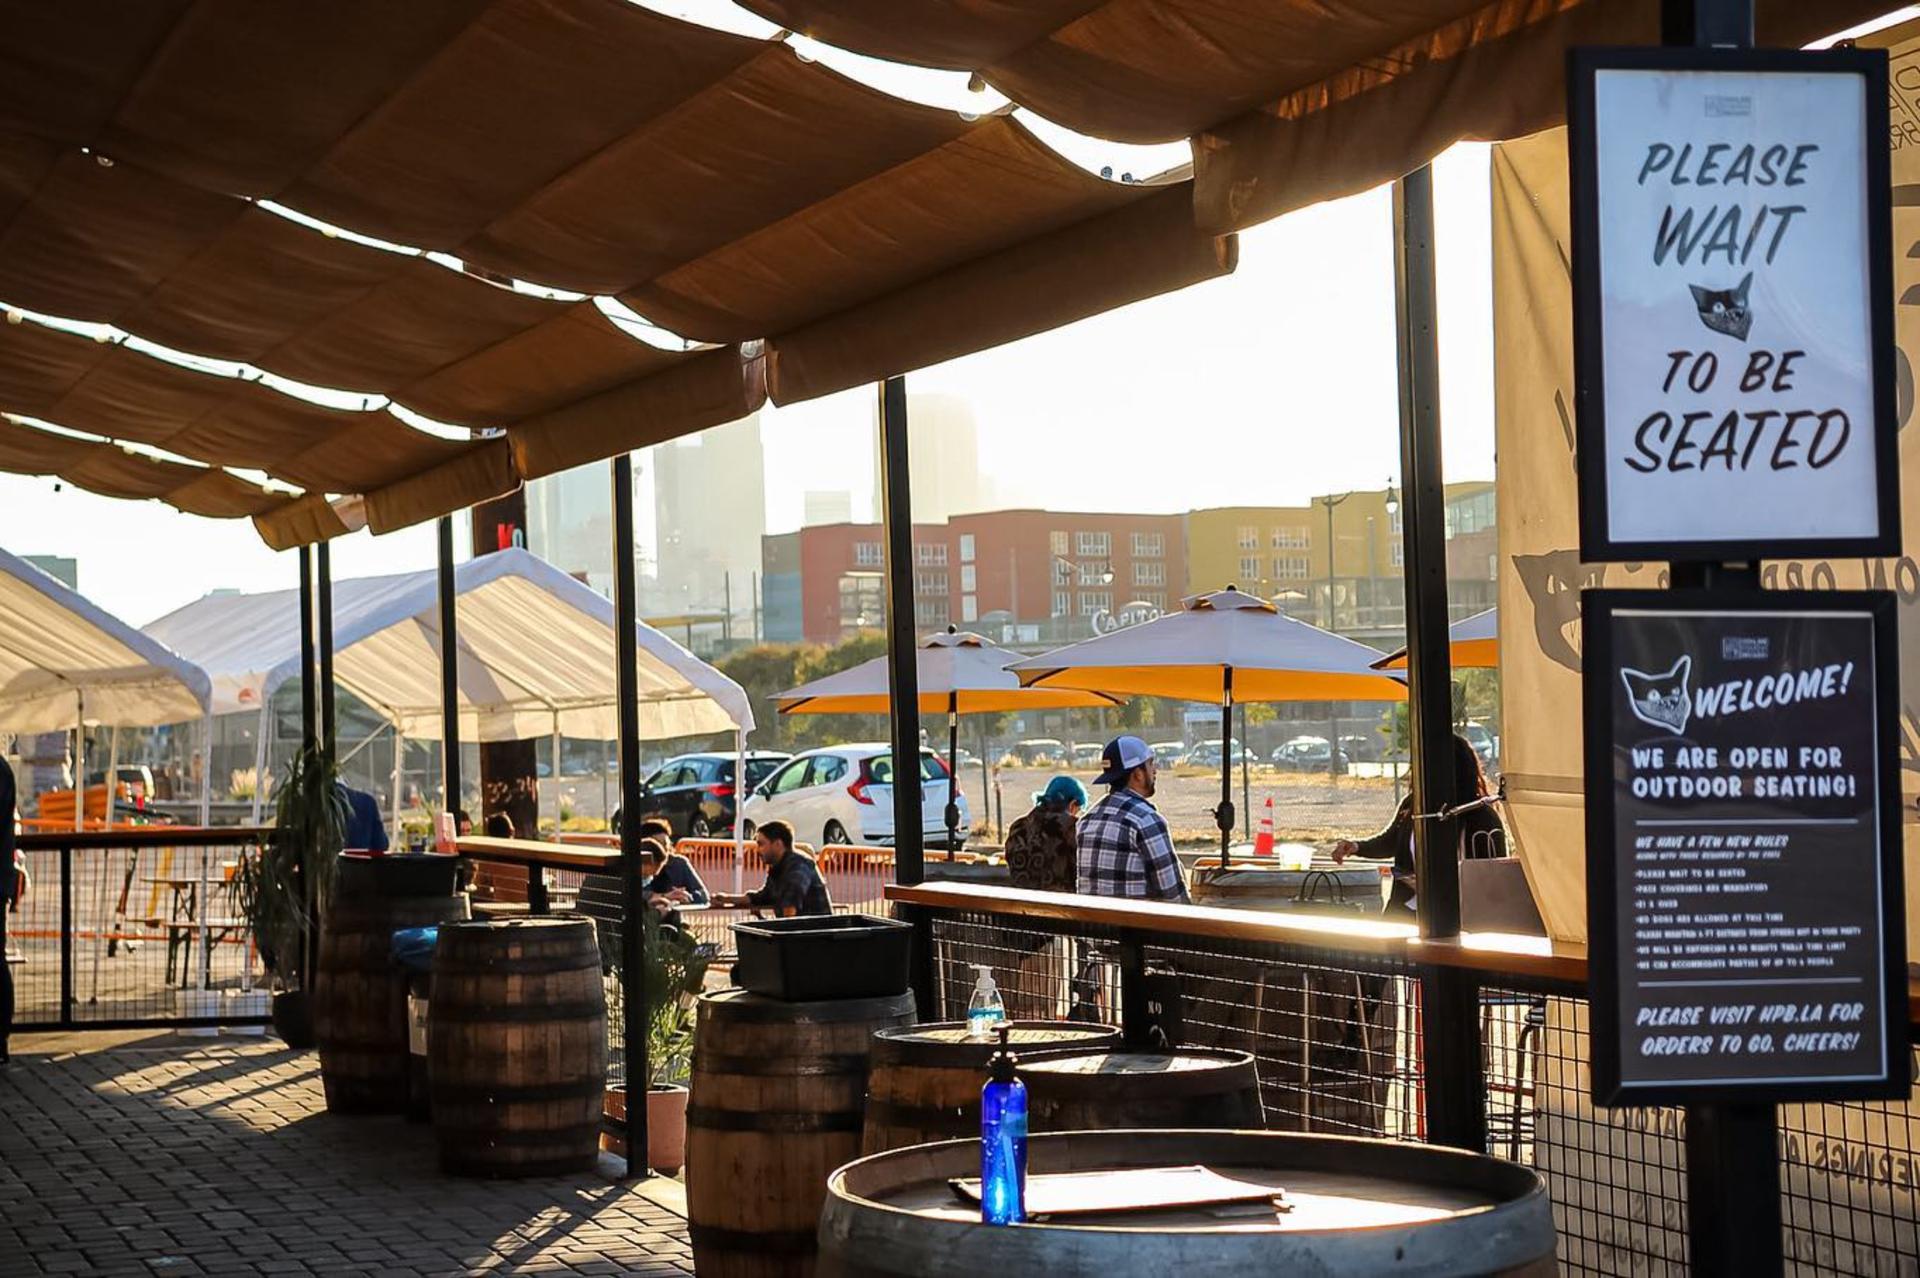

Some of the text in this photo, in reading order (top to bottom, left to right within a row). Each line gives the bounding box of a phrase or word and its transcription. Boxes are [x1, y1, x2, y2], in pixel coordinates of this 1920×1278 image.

[1638, 143, 1820, 186] PLEASE
[1653, 204, 1806, 266] WAIT
[1663, 350, 1806, 393] TO BE
[1623, 408, 1851, 474] SEATED
[1091, 608, 1165, 636] CAPITO
[1694, 661, 1854, 719] WELCOME!
[1632, 746, 1842, 769] WE ARE OPEN FOR
[1632, 774, 1856, 798] OUTDOOR SEATING!
[1636, 834, 1788, 849] WE HAVE A FEW NEW RULES
[1669, 868, 1688, 879] WAIT
[1692, 868, 1702, 878] TO
[1636, 1003, 1863, 1026] PLEASE VISIT HPB.LA FOR
[1641, 1033, 1860, 1055] ORDERS TO GO. CHEERS!
